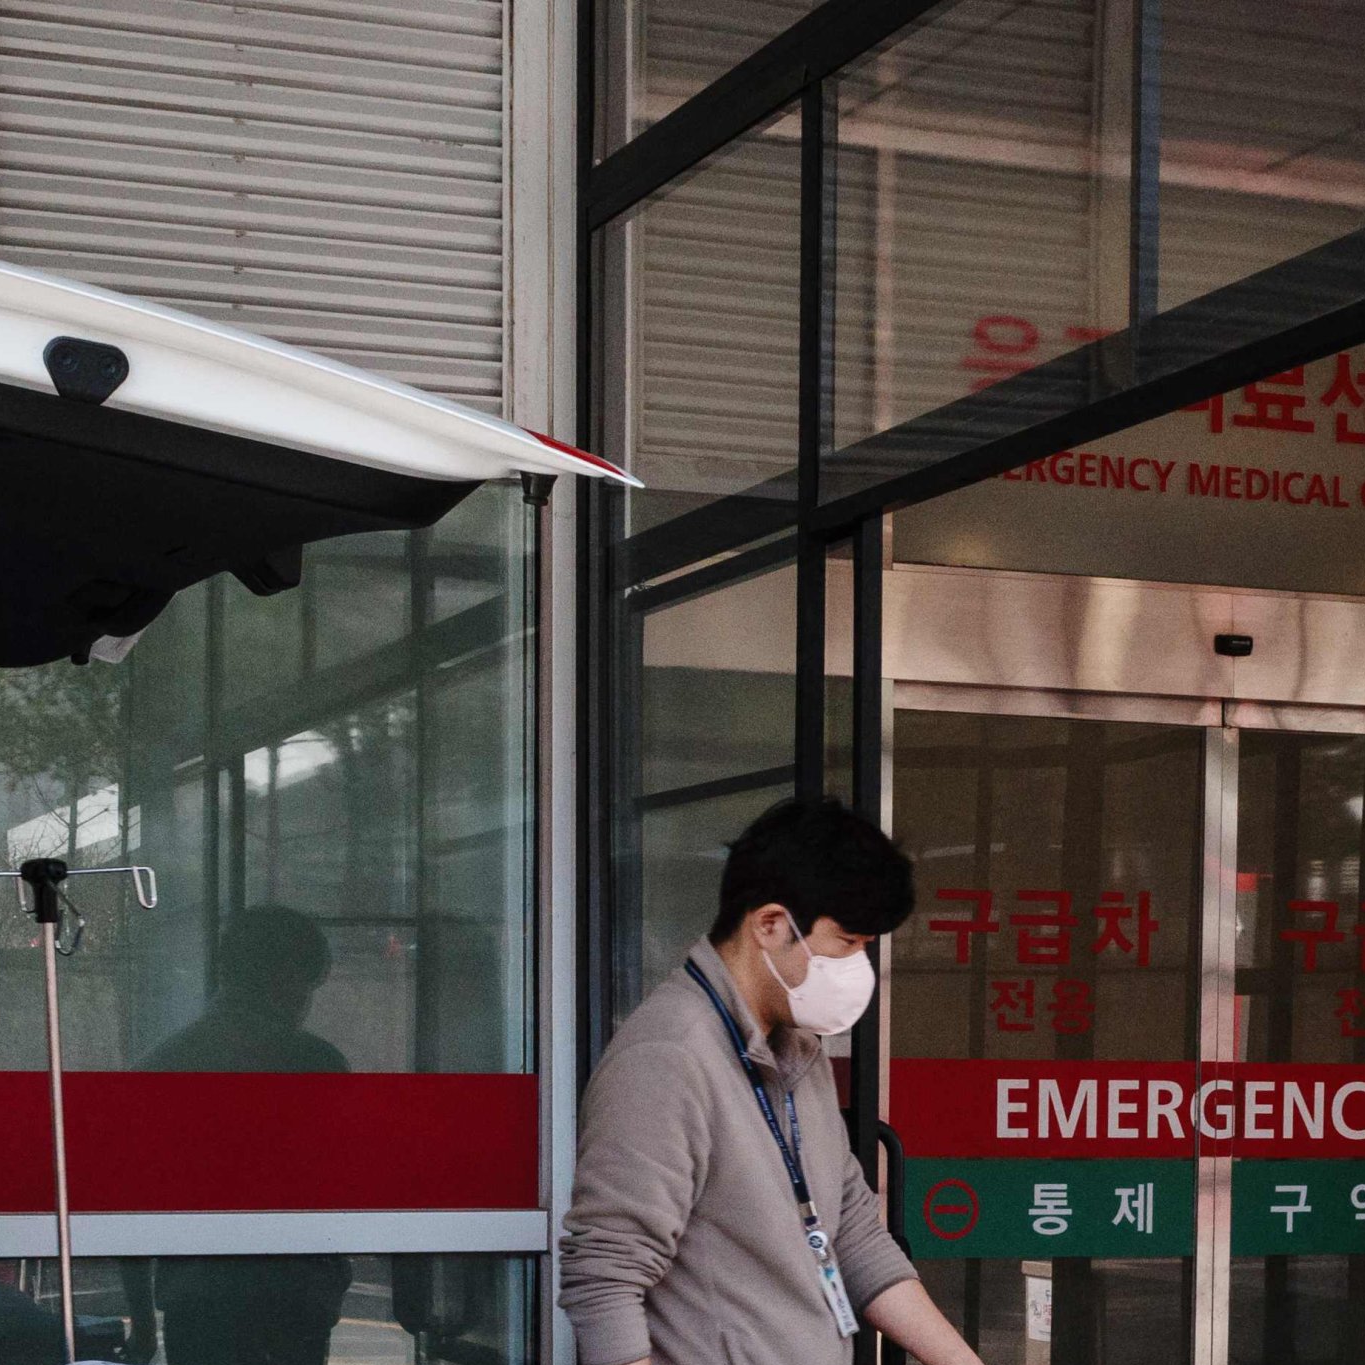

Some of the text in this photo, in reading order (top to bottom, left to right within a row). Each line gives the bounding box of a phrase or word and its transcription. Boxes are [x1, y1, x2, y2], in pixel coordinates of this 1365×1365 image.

[1186, 462, 1350, 509] MEDICAL
[929, 888, 1159, 967] 구급차
[990, 978, 1097, 1035] 전용
